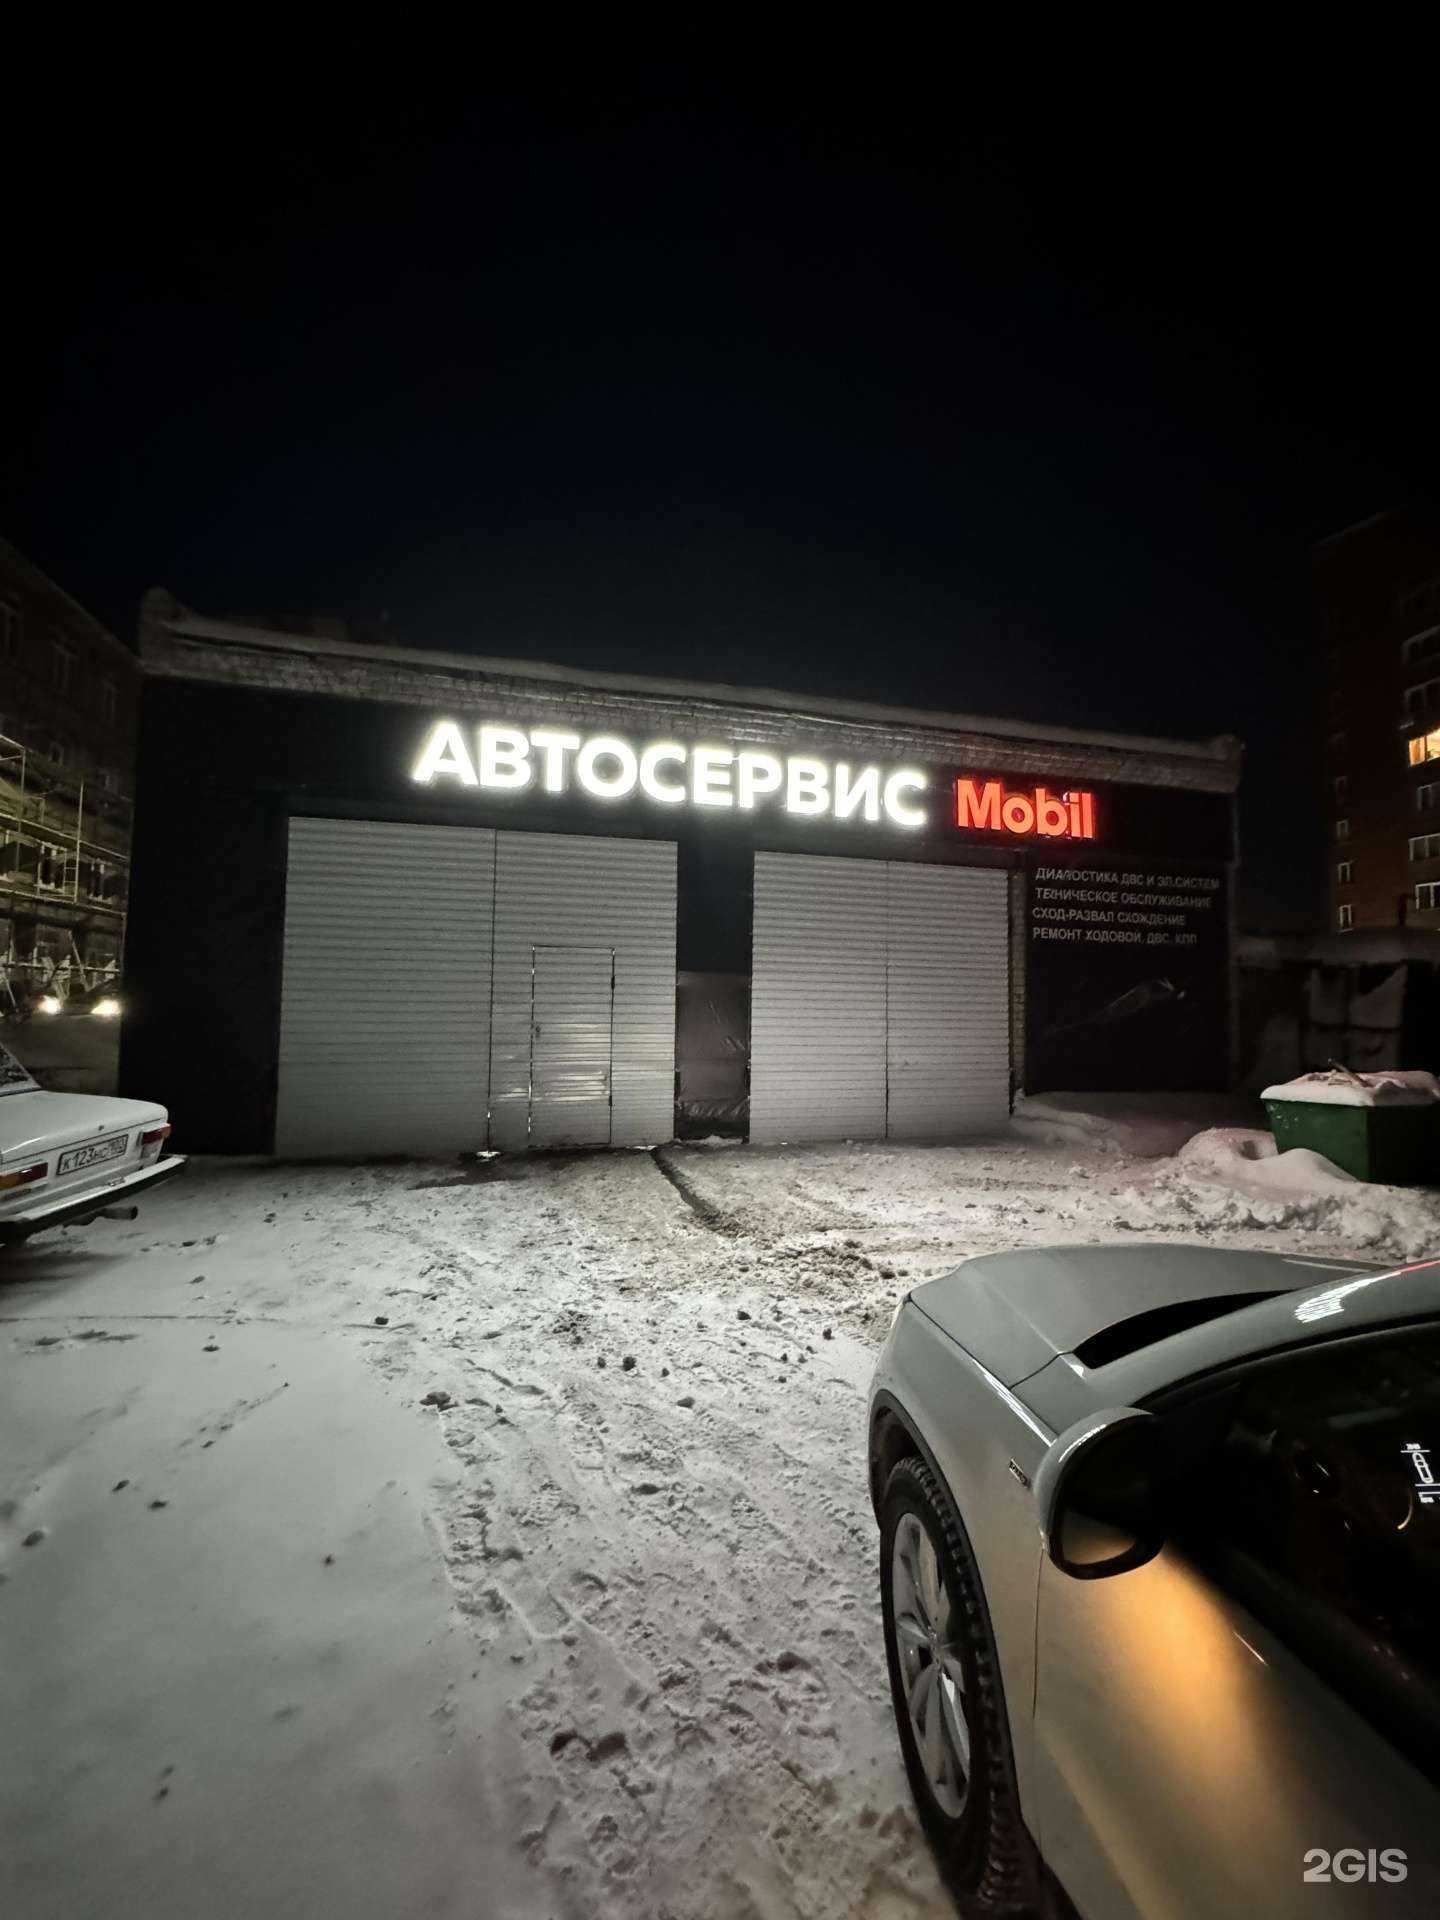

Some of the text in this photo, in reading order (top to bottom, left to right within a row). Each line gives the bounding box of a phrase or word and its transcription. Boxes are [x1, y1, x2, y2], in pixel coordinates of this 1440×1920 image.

[413, 720, 929, 828] АВТОСЕРВИС
[956, 778, 1094, 839] Mobil
[1120, 873, 1144, 887] ДВС
[1146, 875, 1155, 887] И
[1121, 892, 1211, 909] ОБСЛУЖИВАНИЕ
[1032, 907, 1185, 926] СХОД-РАЗВАЛ СХОЖДЕНИЕ
[1032, 926, 1082, 940] РЕМОНТ
